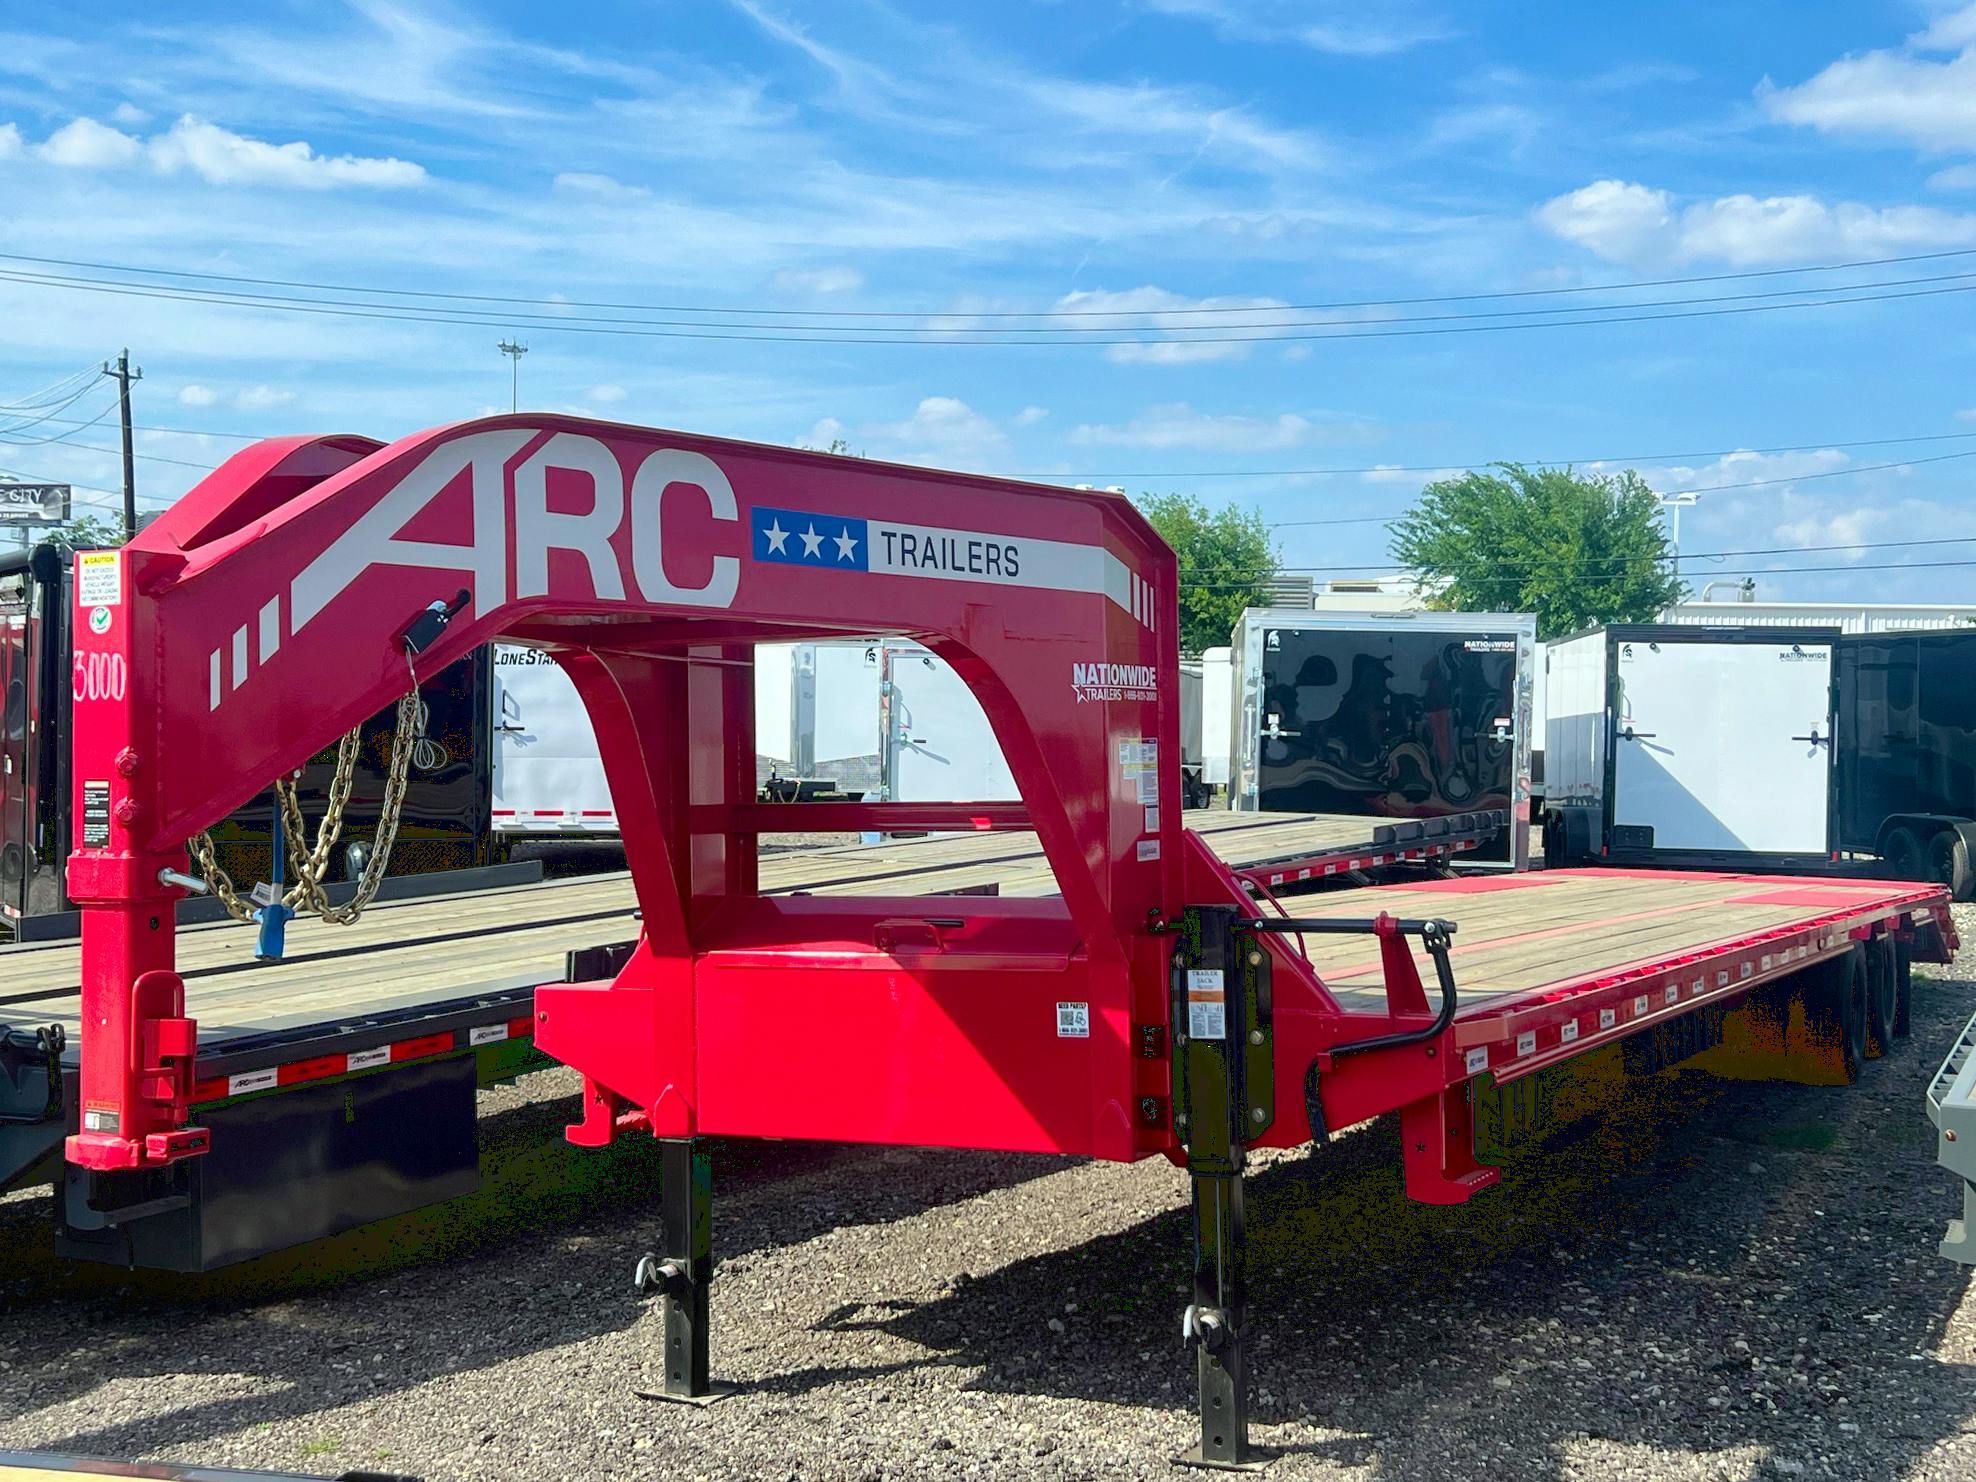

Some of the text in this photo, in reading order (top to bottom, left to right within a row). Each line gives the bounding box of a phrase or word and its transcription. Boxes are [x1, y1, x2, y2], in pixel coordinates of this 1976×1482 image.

[291, 428, 740, 620] ARC
[90, 556, 114, 564] CAUTION
[880, 531, 1019, 577] TRAILERS
[1464, 640, 1515, 648] NATIONWIDE
[72, 649, 127, 702] 3000
[1073, 663, 1156, 688] NATIONWIDE
[1085, 688, 1122, 701] TRAILERS
